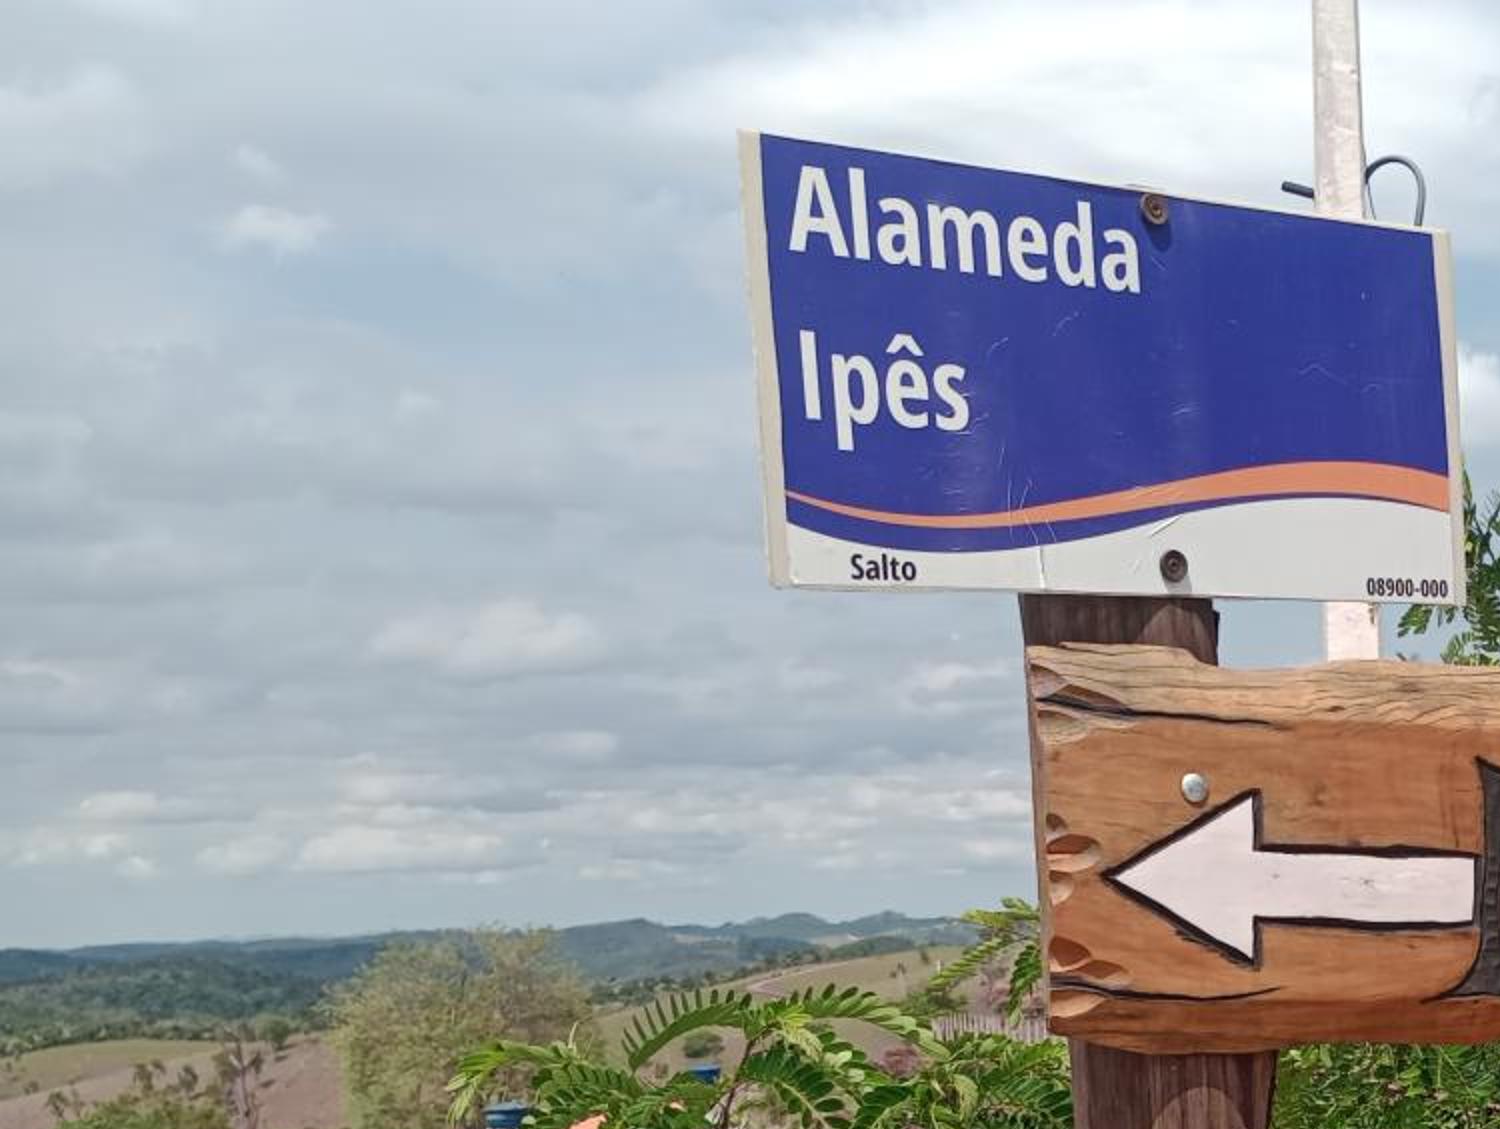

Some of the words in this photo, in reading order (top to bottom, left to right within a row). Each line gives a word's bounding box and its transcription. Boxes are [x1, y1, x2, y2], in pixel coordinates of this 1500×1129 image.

[788, 165, 1142, 295] Alameda
[798, 329, 970, 452] Ipês
[850, 552, 918, 583] Salto
[1365, 577, 1449, 600] 08900-000
